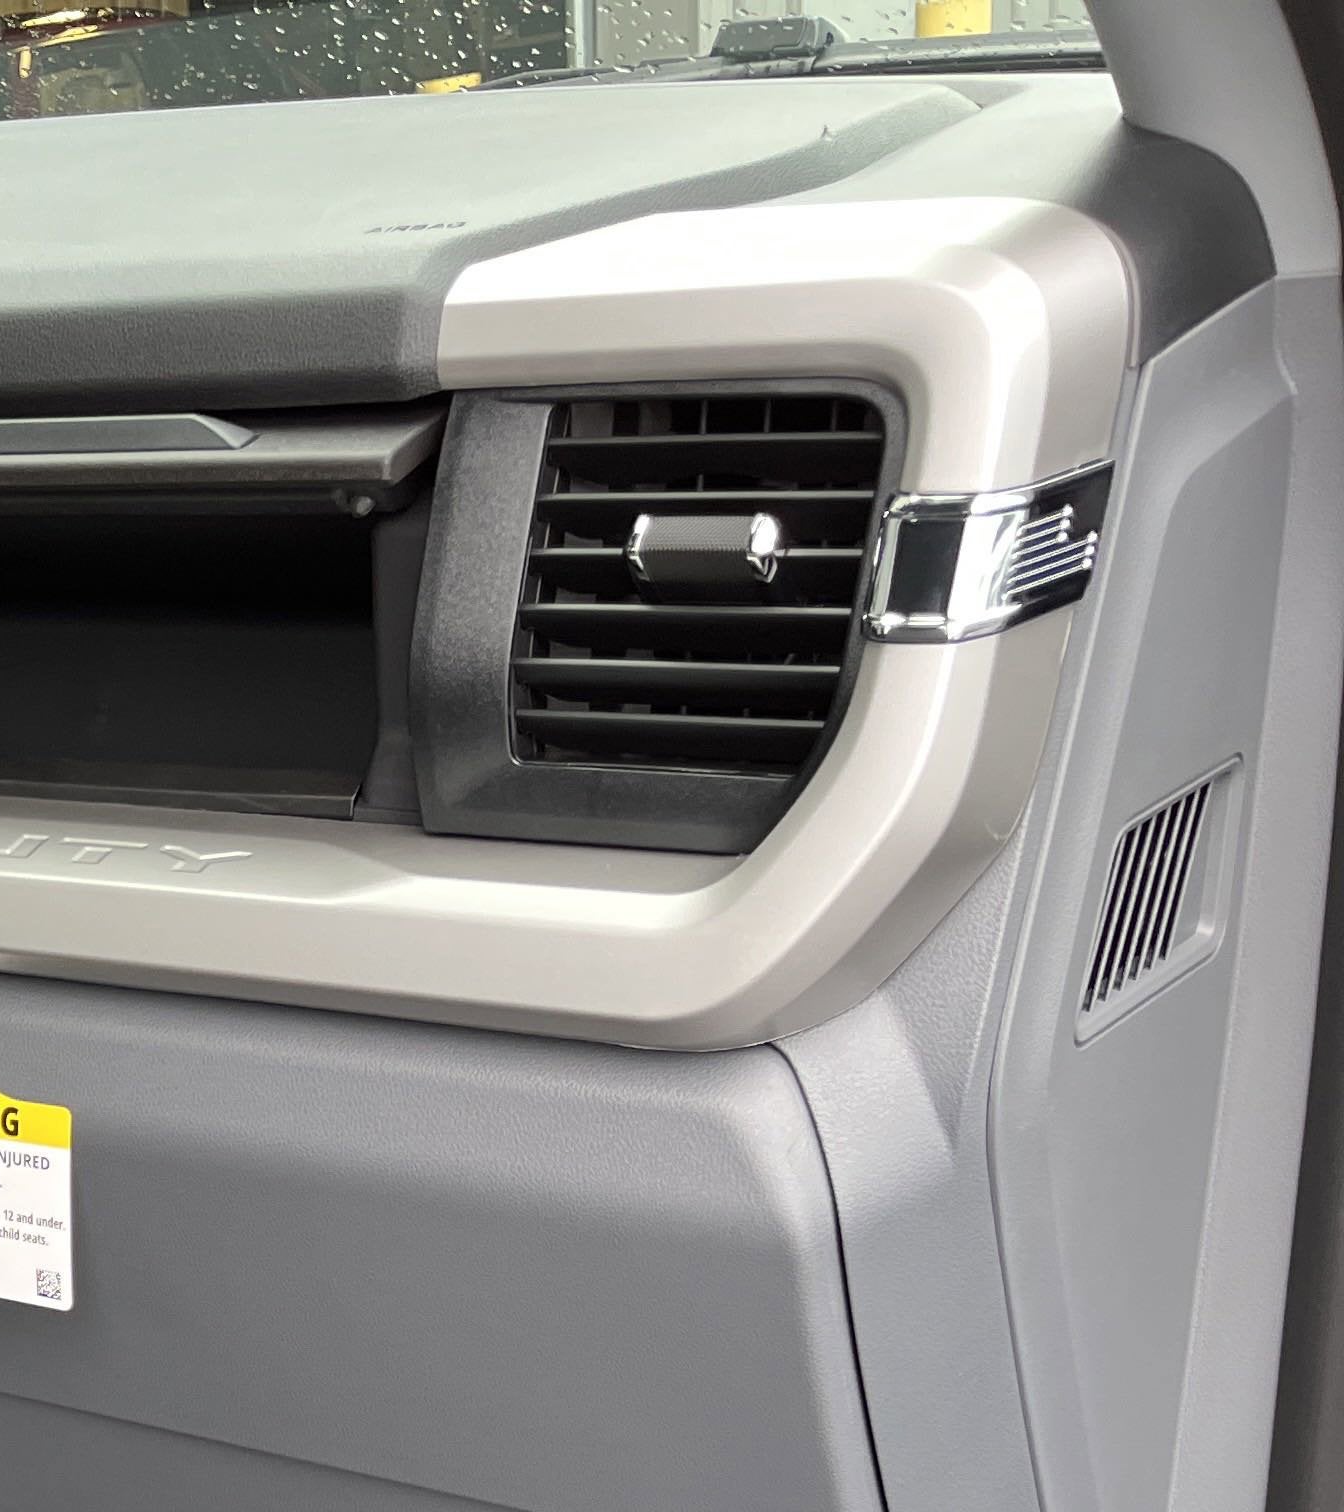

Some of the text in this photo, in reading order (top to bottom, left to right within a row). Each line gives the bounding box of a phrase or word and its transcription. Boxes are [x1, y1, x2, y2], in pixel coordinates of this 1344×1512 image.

[4, 1210, 14, 1221] 12
[16, 1211, 33, 1224] and
[36, 1215, 66, 1231] under.
[0, 1226, 20, 1241] child
[22, 1233, 49, 1246] seats.
